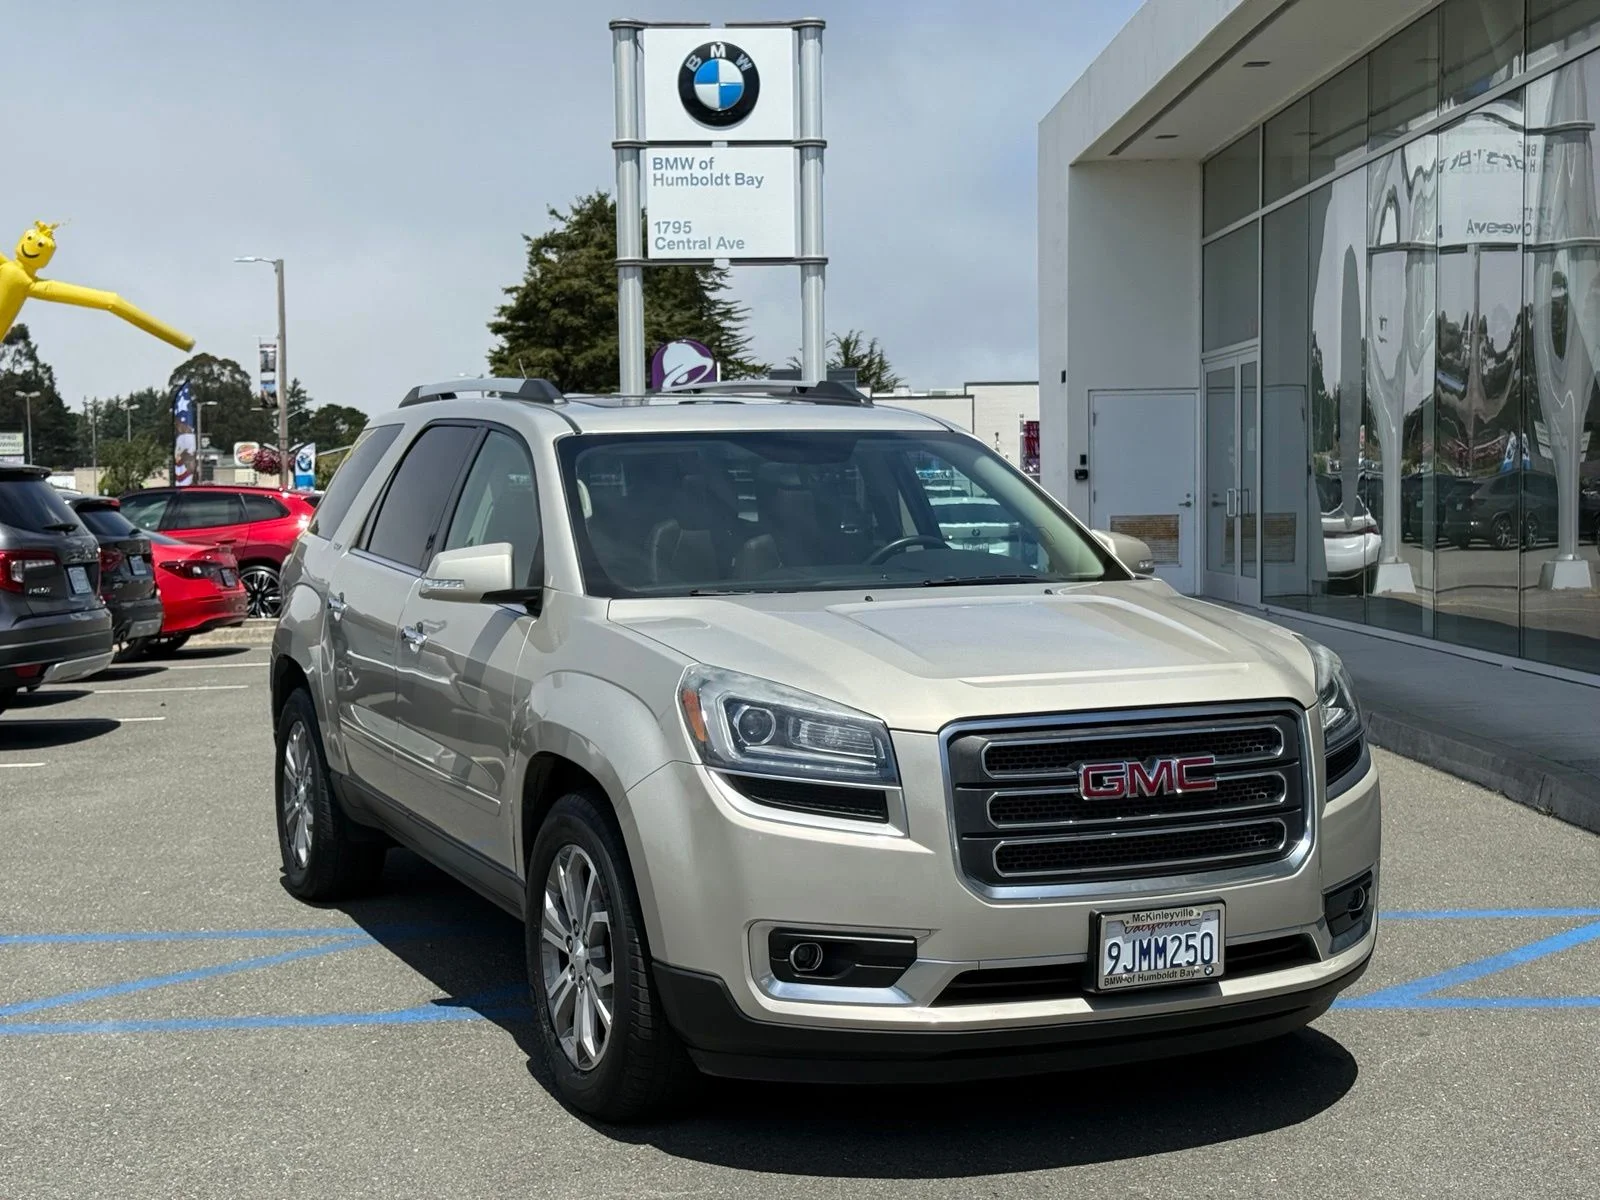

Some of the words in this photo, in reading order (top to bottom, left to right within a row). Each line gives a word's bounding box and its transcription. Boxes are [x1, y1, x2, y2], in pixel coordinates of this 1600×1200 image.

[685, 41, 752, 73] BMW
[652, 157, 695, 170] BMW
[699, 157, 714, 170] of
[652, 173, 730, 187] Humboldt
[734, 172, 764, 188] Bay
[654, 221, 692, 234] 1795
[654, 237, 712, 250] Central
[715, 237, 745, 250] Ave
[1079, 754, 1218, 801] GMC
[1132, 908, 1194, 923] McKinleyville
[1107, 931, 1213, 976] 9JMM250
[1103, 977, 1123, 987] BMW
[1127, 974, 1135, 983] of
[1137, 970, 1178, 982] Humboldt
[1179, 969, 1195, 978] Bay
